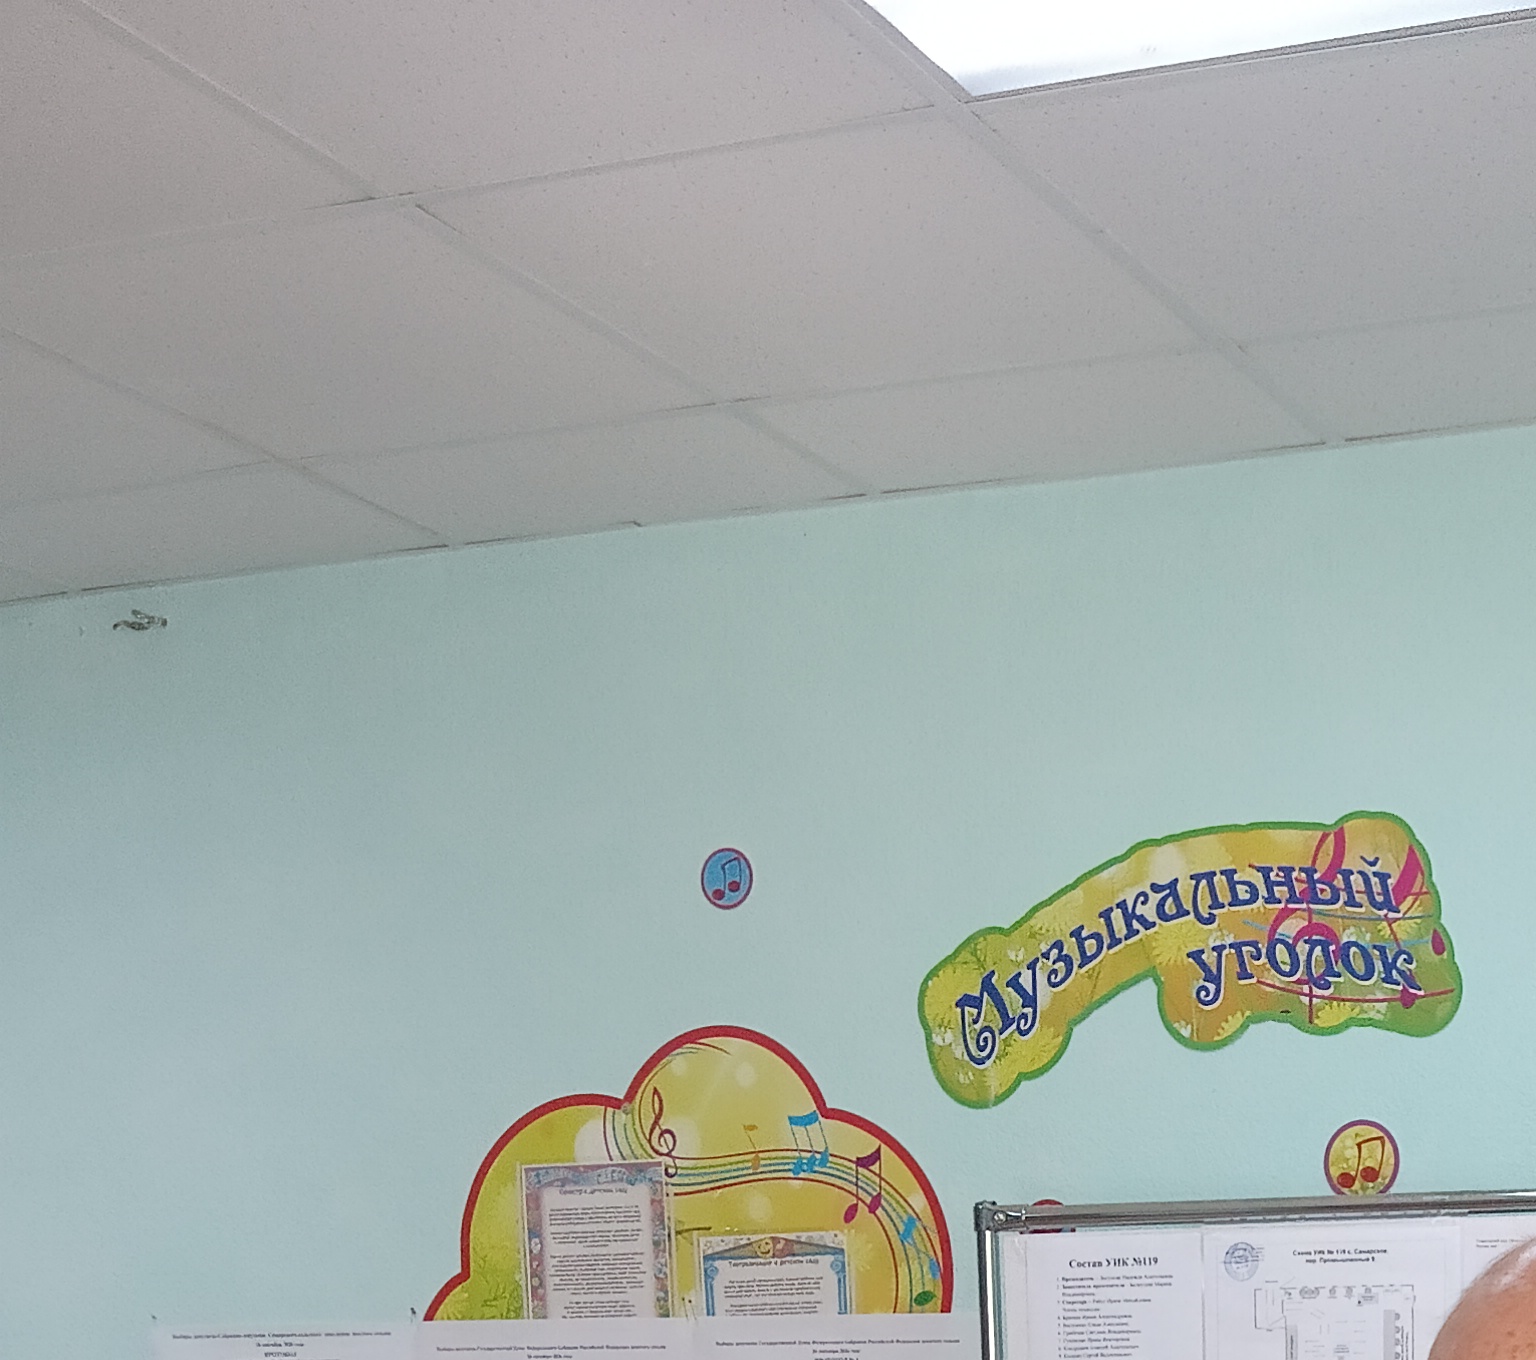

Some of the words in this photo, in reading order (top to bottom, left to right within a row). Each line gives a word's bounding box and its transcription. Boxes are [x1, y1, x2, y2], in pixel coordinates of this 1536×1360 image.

[955, 856, 1400, 1068] Музыкальный
[1186, 938, 1424, 1008] уголок
[1068, 1259, 1103, 1269] Состав
[1105, 1257, 1130, 1267] УИК
